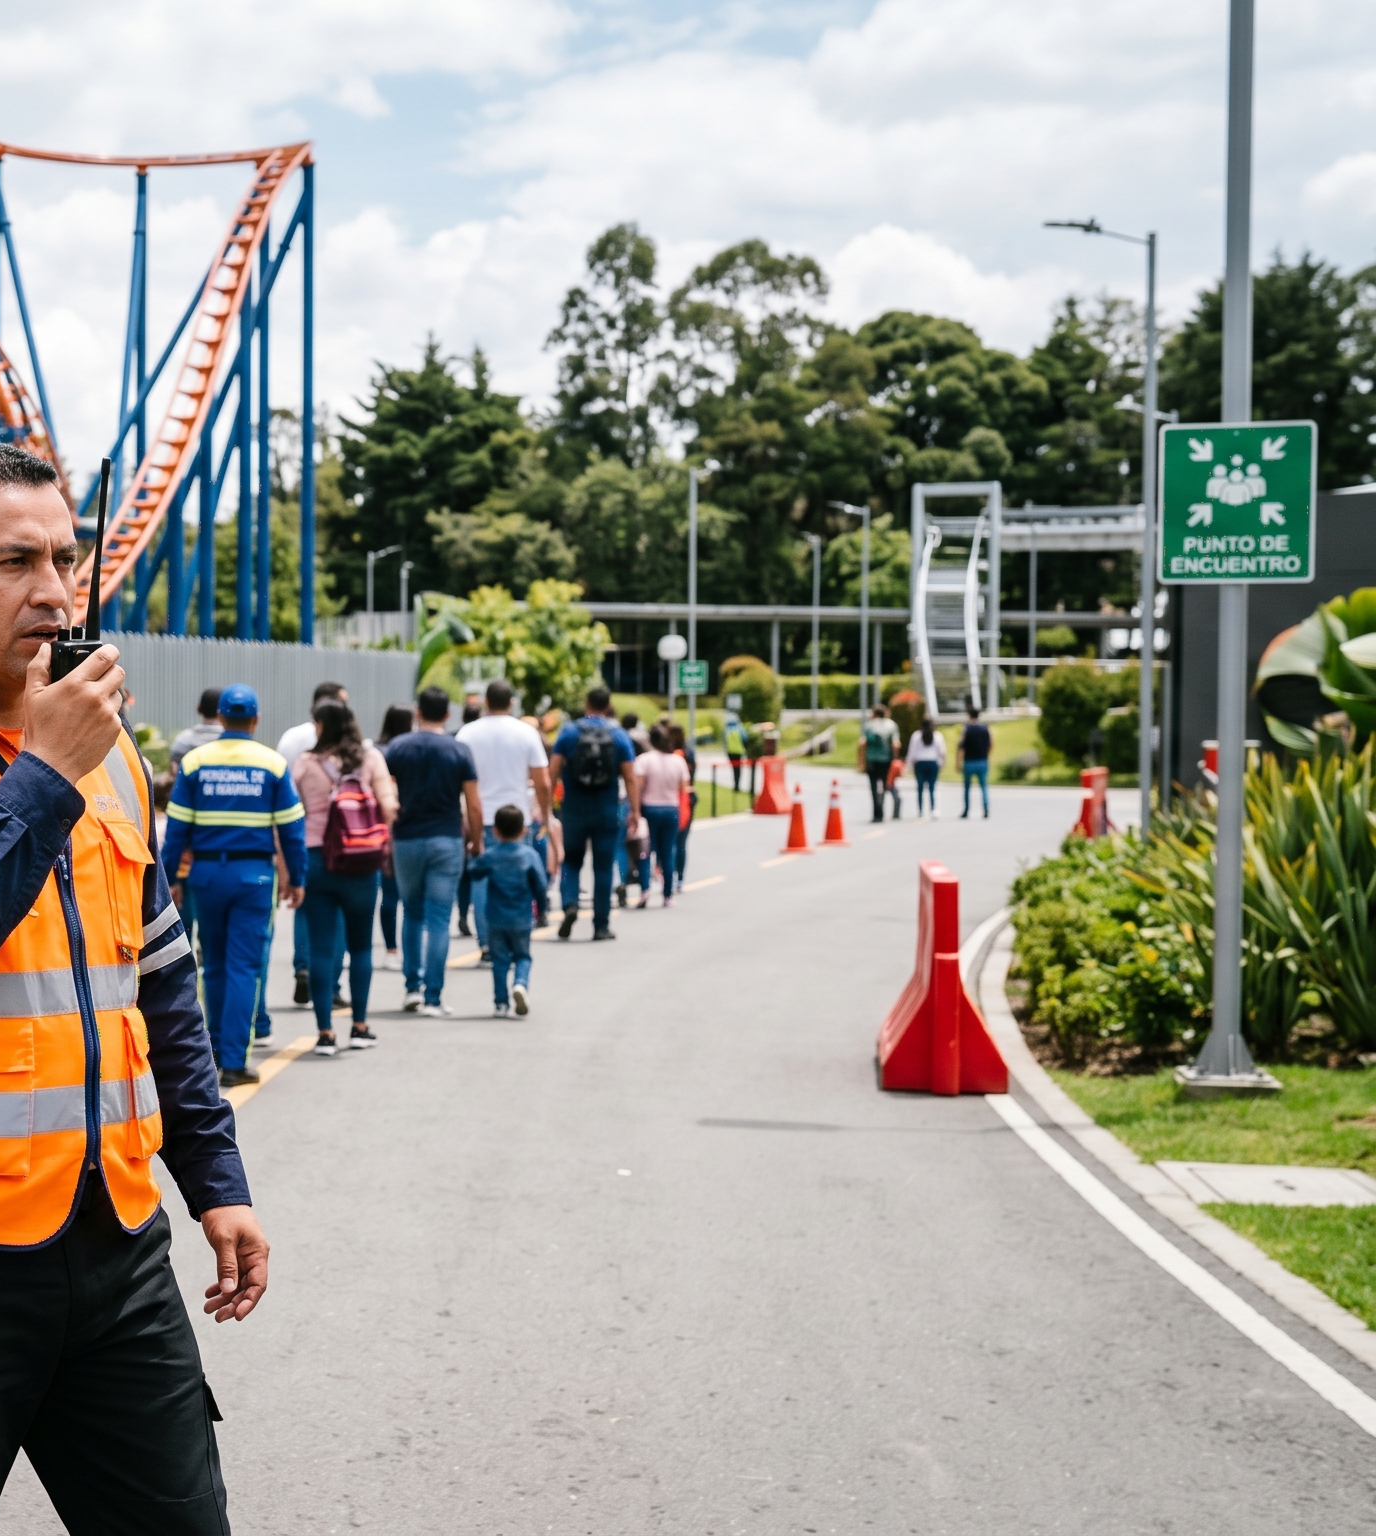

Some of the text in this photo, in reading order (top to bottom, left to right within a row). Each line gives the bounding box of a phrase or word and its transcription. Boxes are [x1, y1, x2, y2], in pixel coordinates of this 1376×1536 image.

[1183, 534, 1290, 553] PUNTO DE
[1170, 555, 1301, 574] ENCUENTRO
